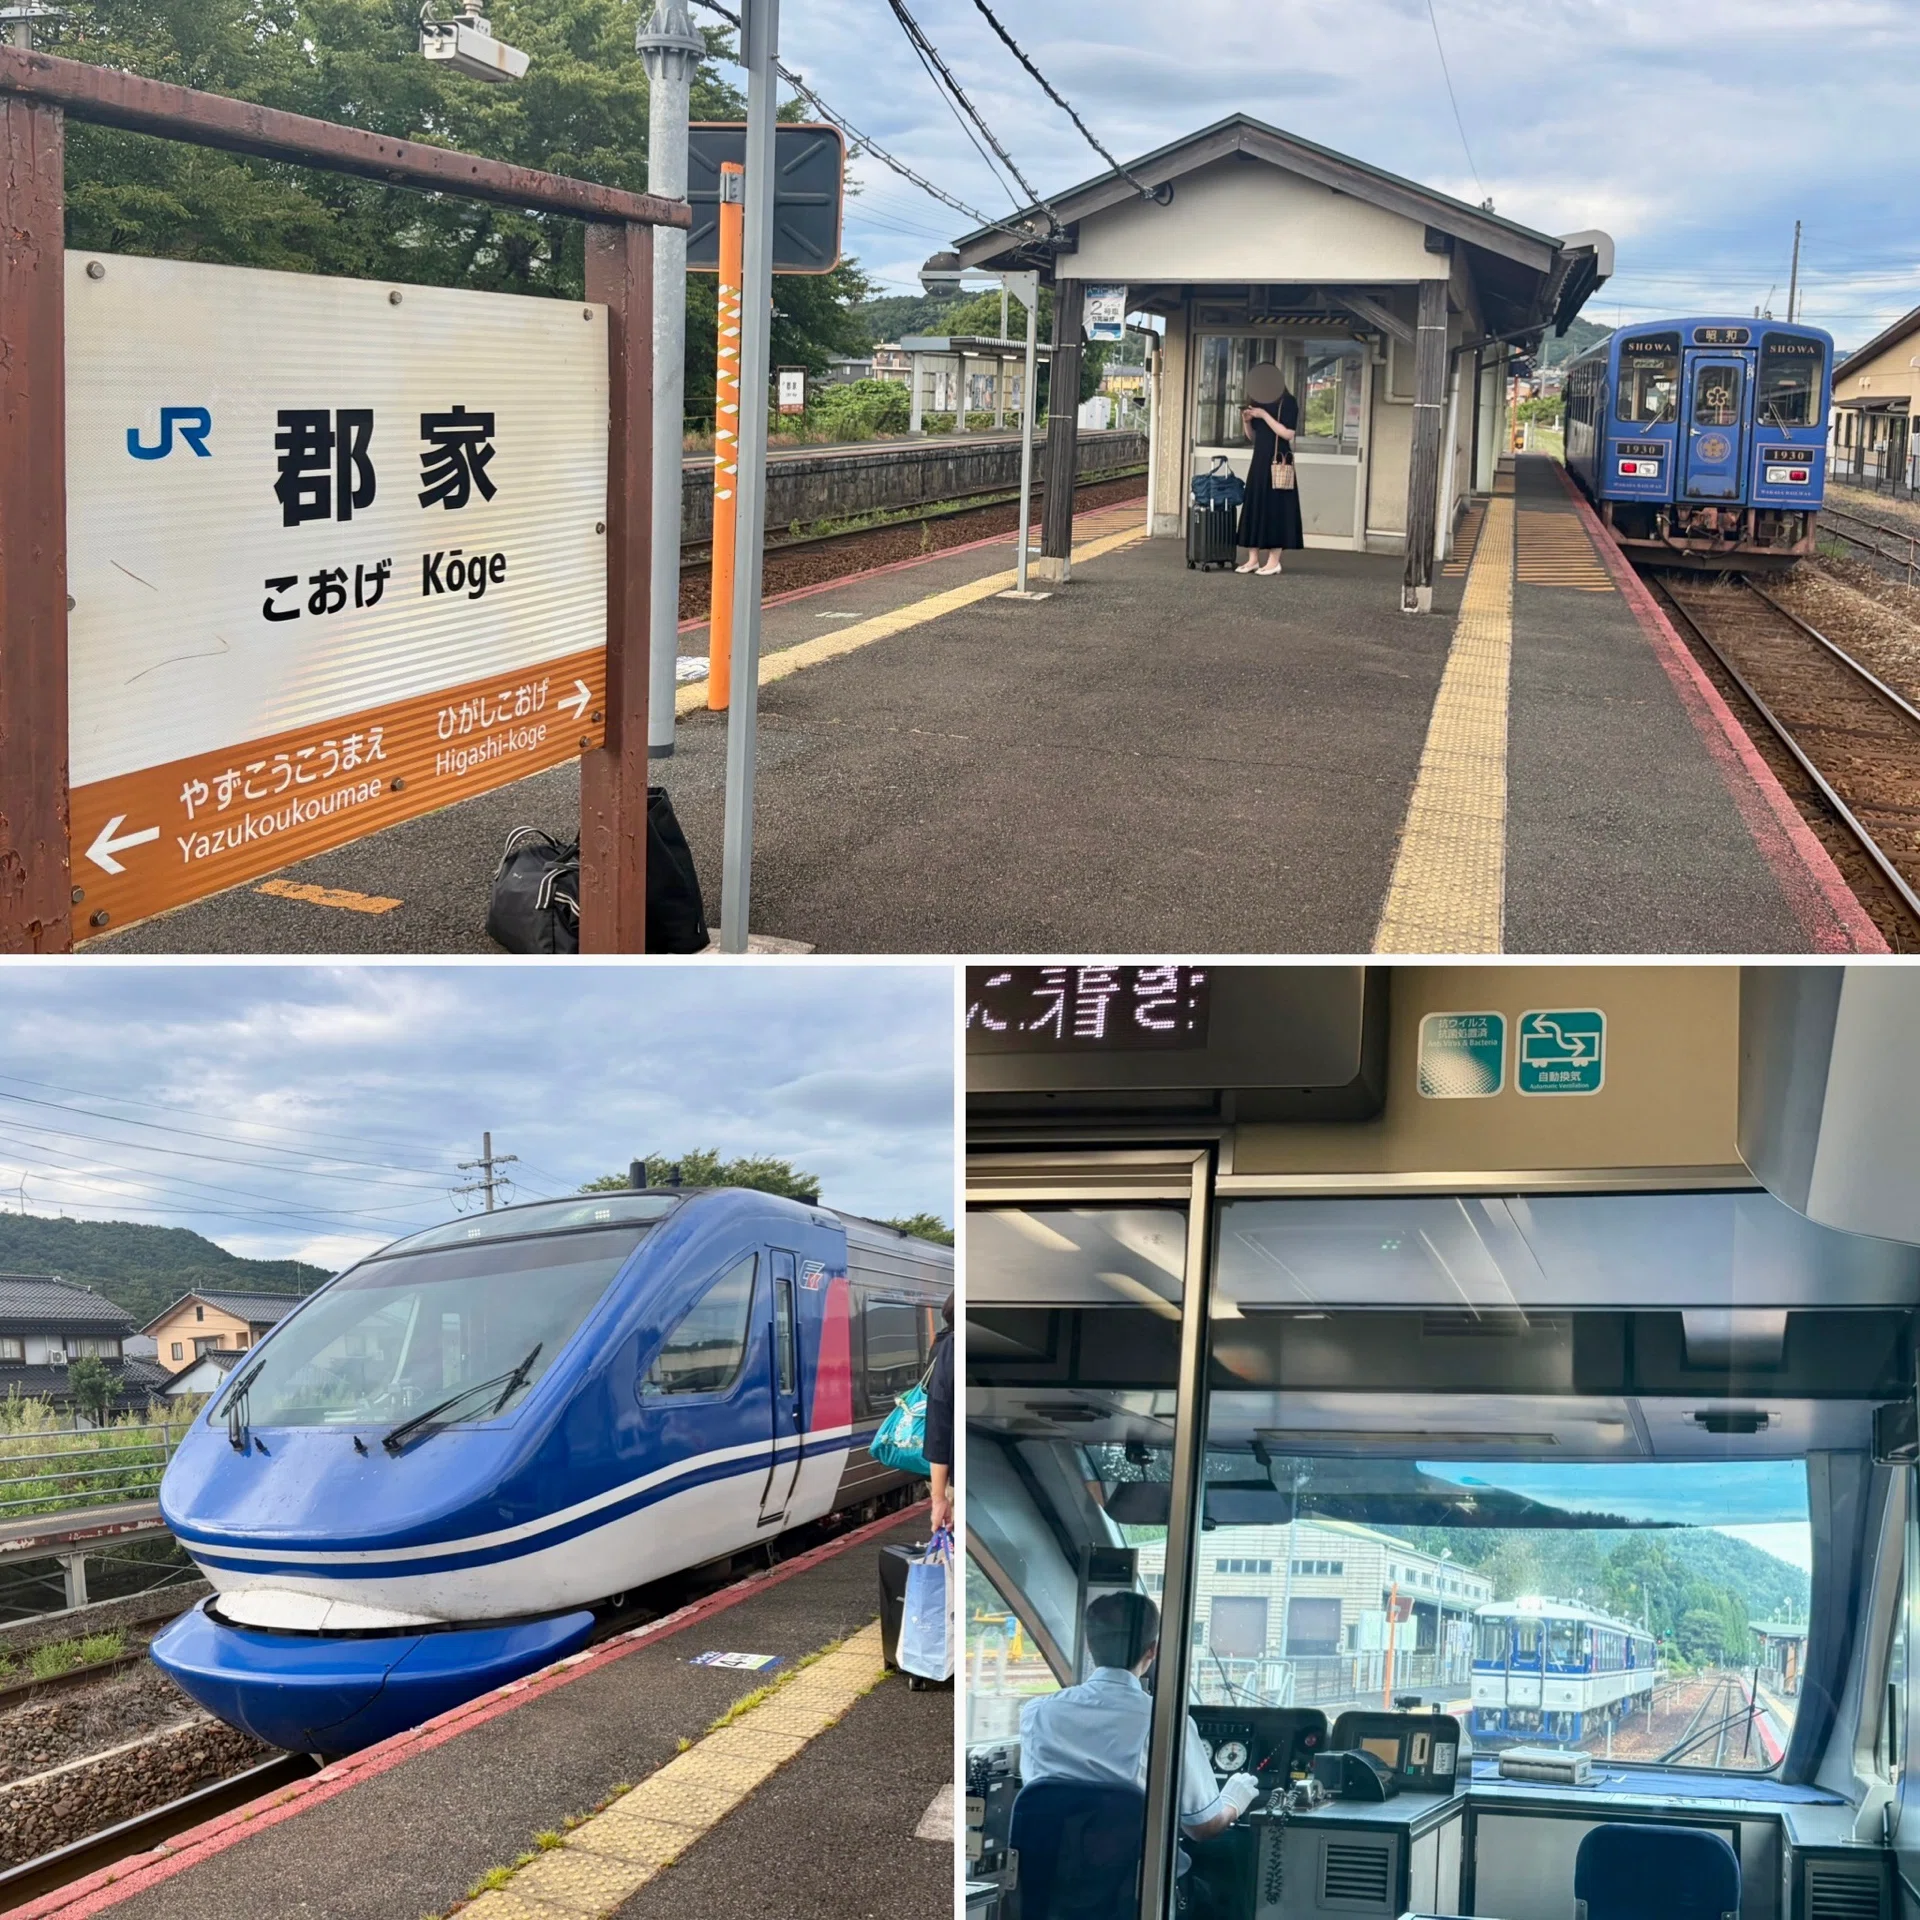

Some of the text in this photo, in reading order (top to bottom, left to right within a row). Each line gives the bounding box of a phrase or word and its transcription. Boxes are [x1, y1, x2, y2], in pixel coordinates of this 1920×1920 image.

[1628, 343, 1672, 352] SHOWA
[1705, 329, 1738, 340] 昭和
[1770, 344, 1815, 354] SHOWA
[126, 406, 212, 461] JR
[1625, 445, 1656, 455] 1930
[273, 404, 499, 528] 郡家
[1773, 450, 1805, 461] 1930
[261, 549, 508, 622] こおげ Kōge
[436, 677, 550, 740] ひがしこおげ
[435, 722, 548, 777] Higashi-kōge
[179, 725, 388, 820] やずこうこうまえ
[176, 774, 383, 864] Yazukoukoumae
[1438, 1018, 1488, 1028] 抗ウイルス
[1538, 1071, 1582, 1082] 自動換気
